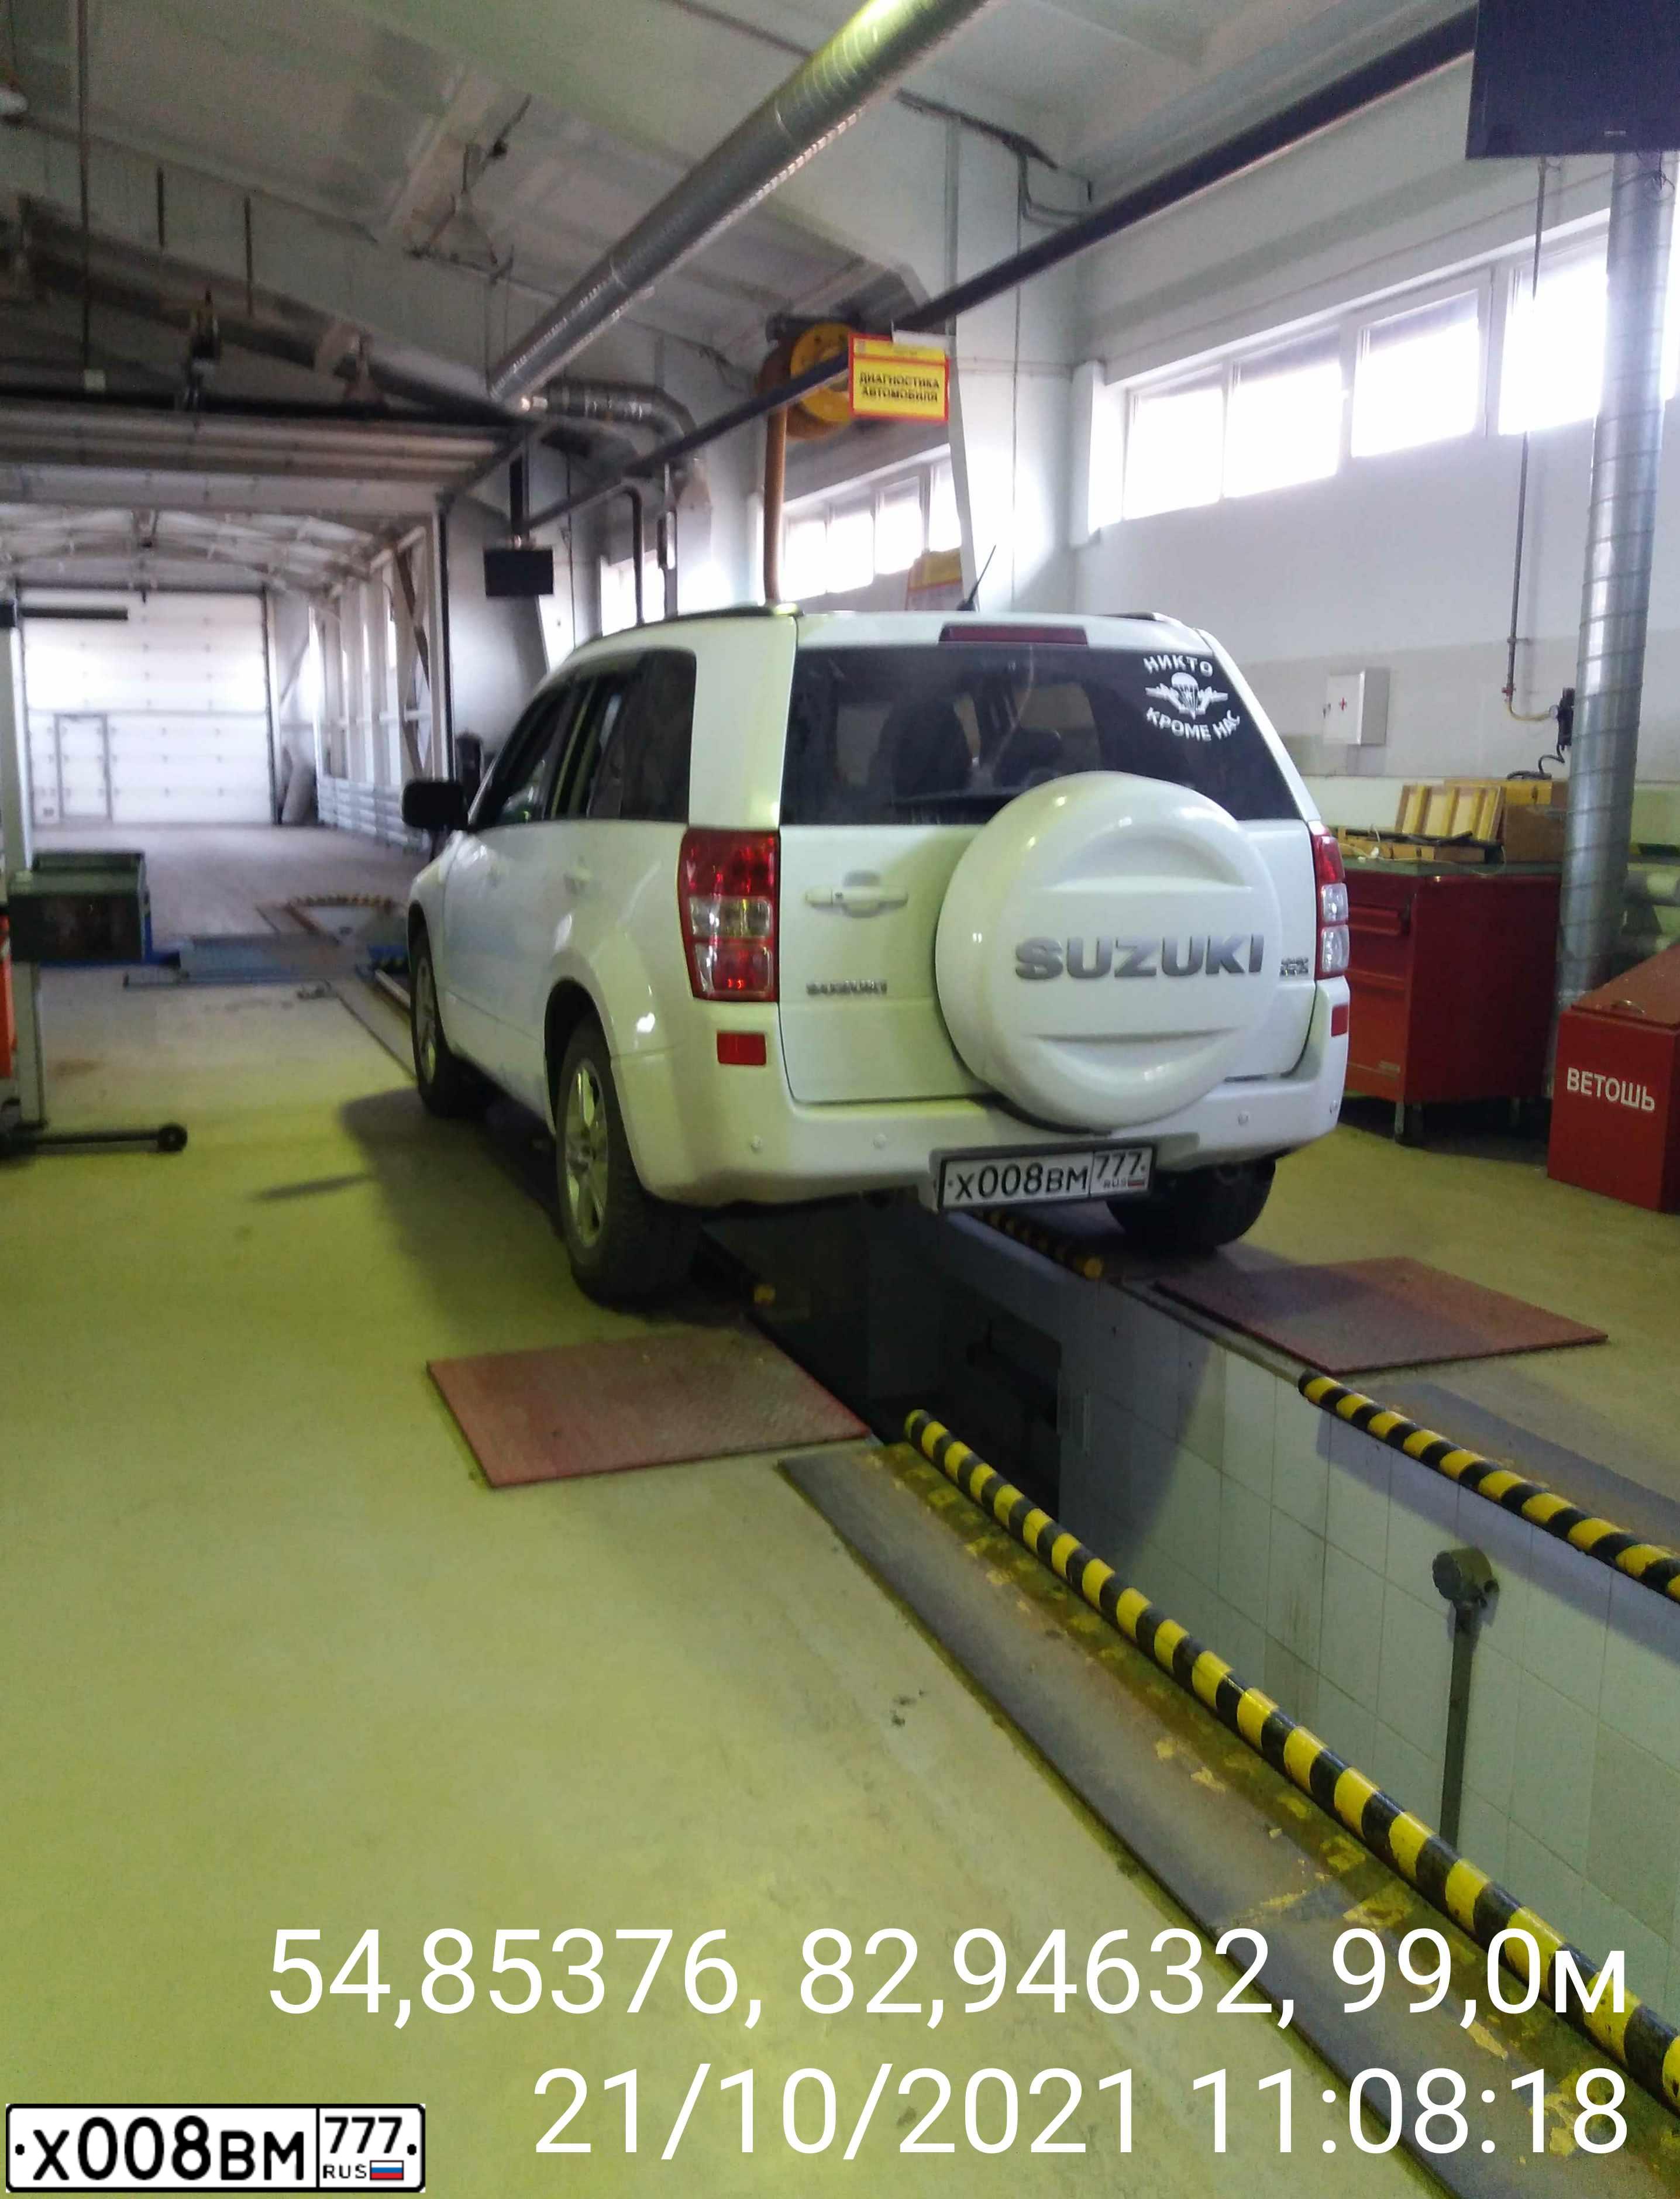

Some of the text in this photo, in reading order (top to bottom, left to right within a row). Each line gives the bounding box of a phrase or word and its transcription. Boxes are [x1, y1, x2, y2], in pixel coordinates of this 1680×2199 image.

[860, 372, 939, 389] ДИАГНОСТИКА
[862, 387, 938, 402] АВТОМОБИЛЯ
[1143, 654, 1213, 677] НИКТО
[1145, 707, 1241, 742] КРОМЕ НАС
[1015, 933, 1265, 979] SUZUKI
[1567, 1066, 1655, 1111] ВЕТОШЬ
